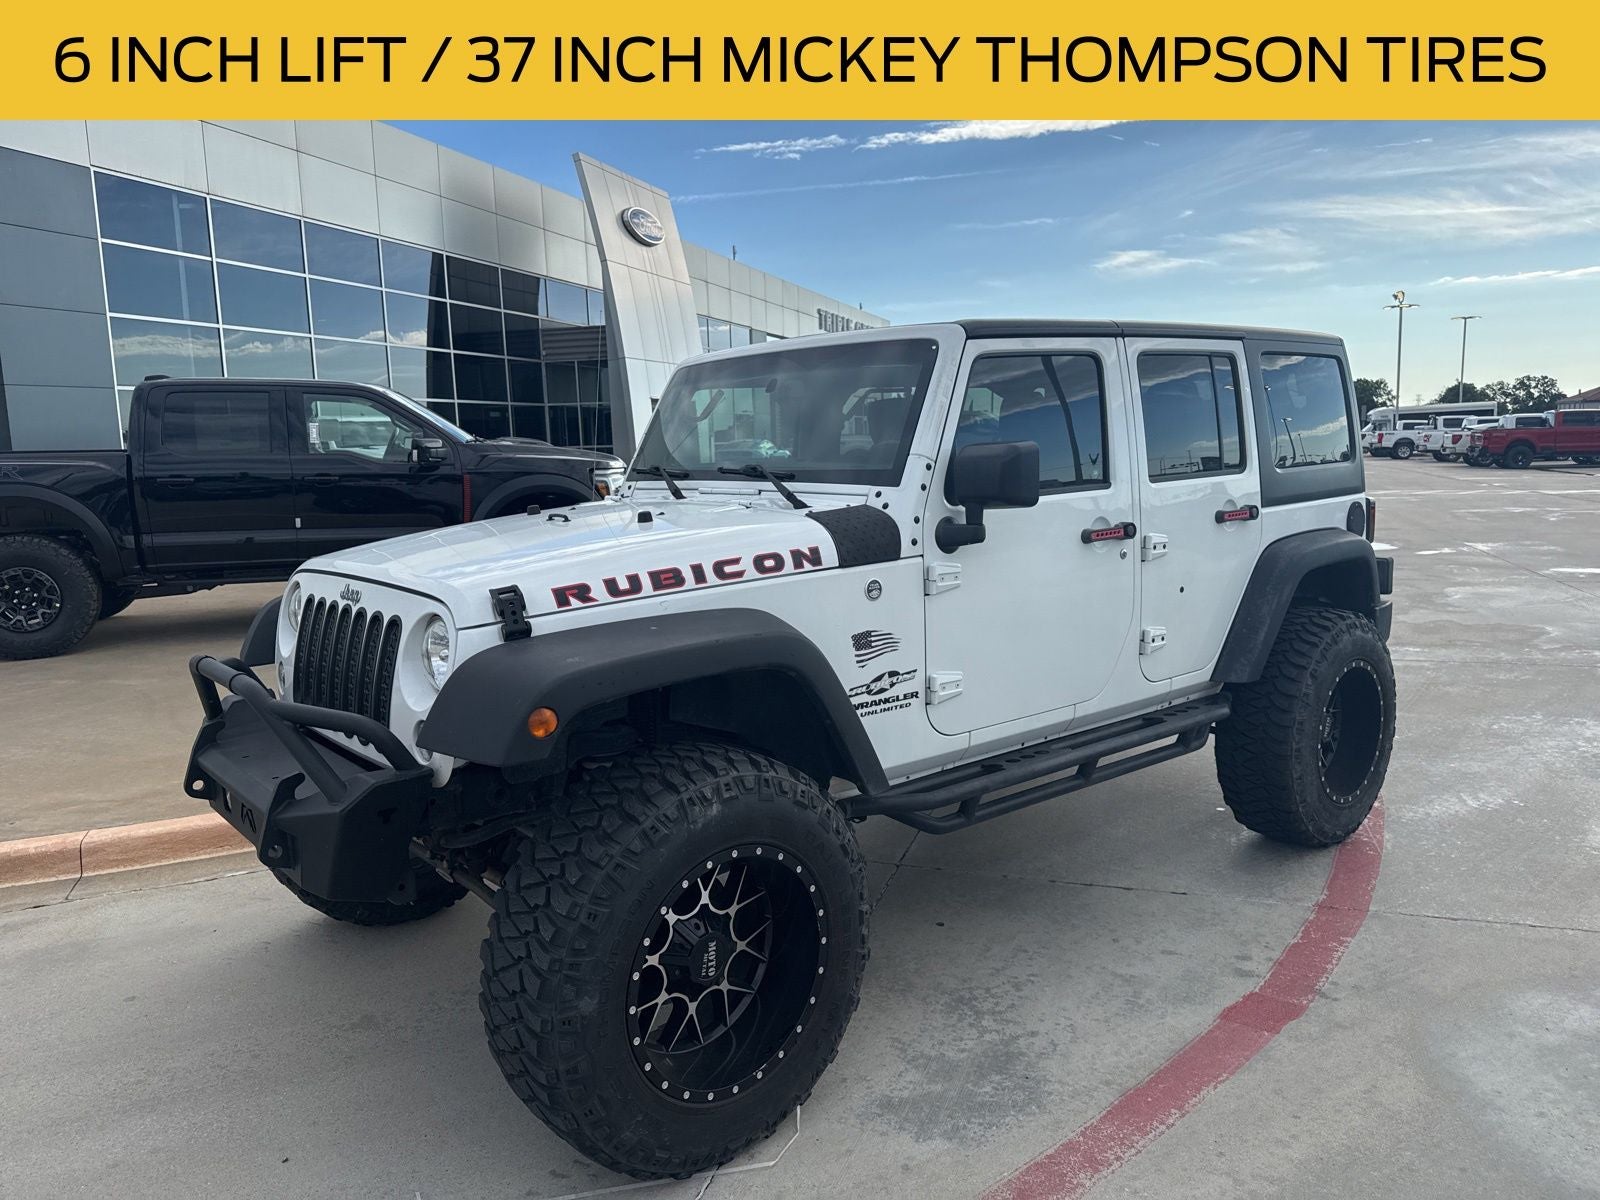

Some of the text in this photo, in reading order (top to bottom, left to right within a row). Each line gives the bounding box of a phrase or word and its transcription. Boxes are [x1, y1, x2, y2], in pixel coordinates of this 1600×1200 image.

[550, 545, 823, 609] RUBICON
[853, 690, 920, 711] WRANGLER
[860, 702, 912, 718] UNLIMITED
[708, 940, 717, 977] MOTO
